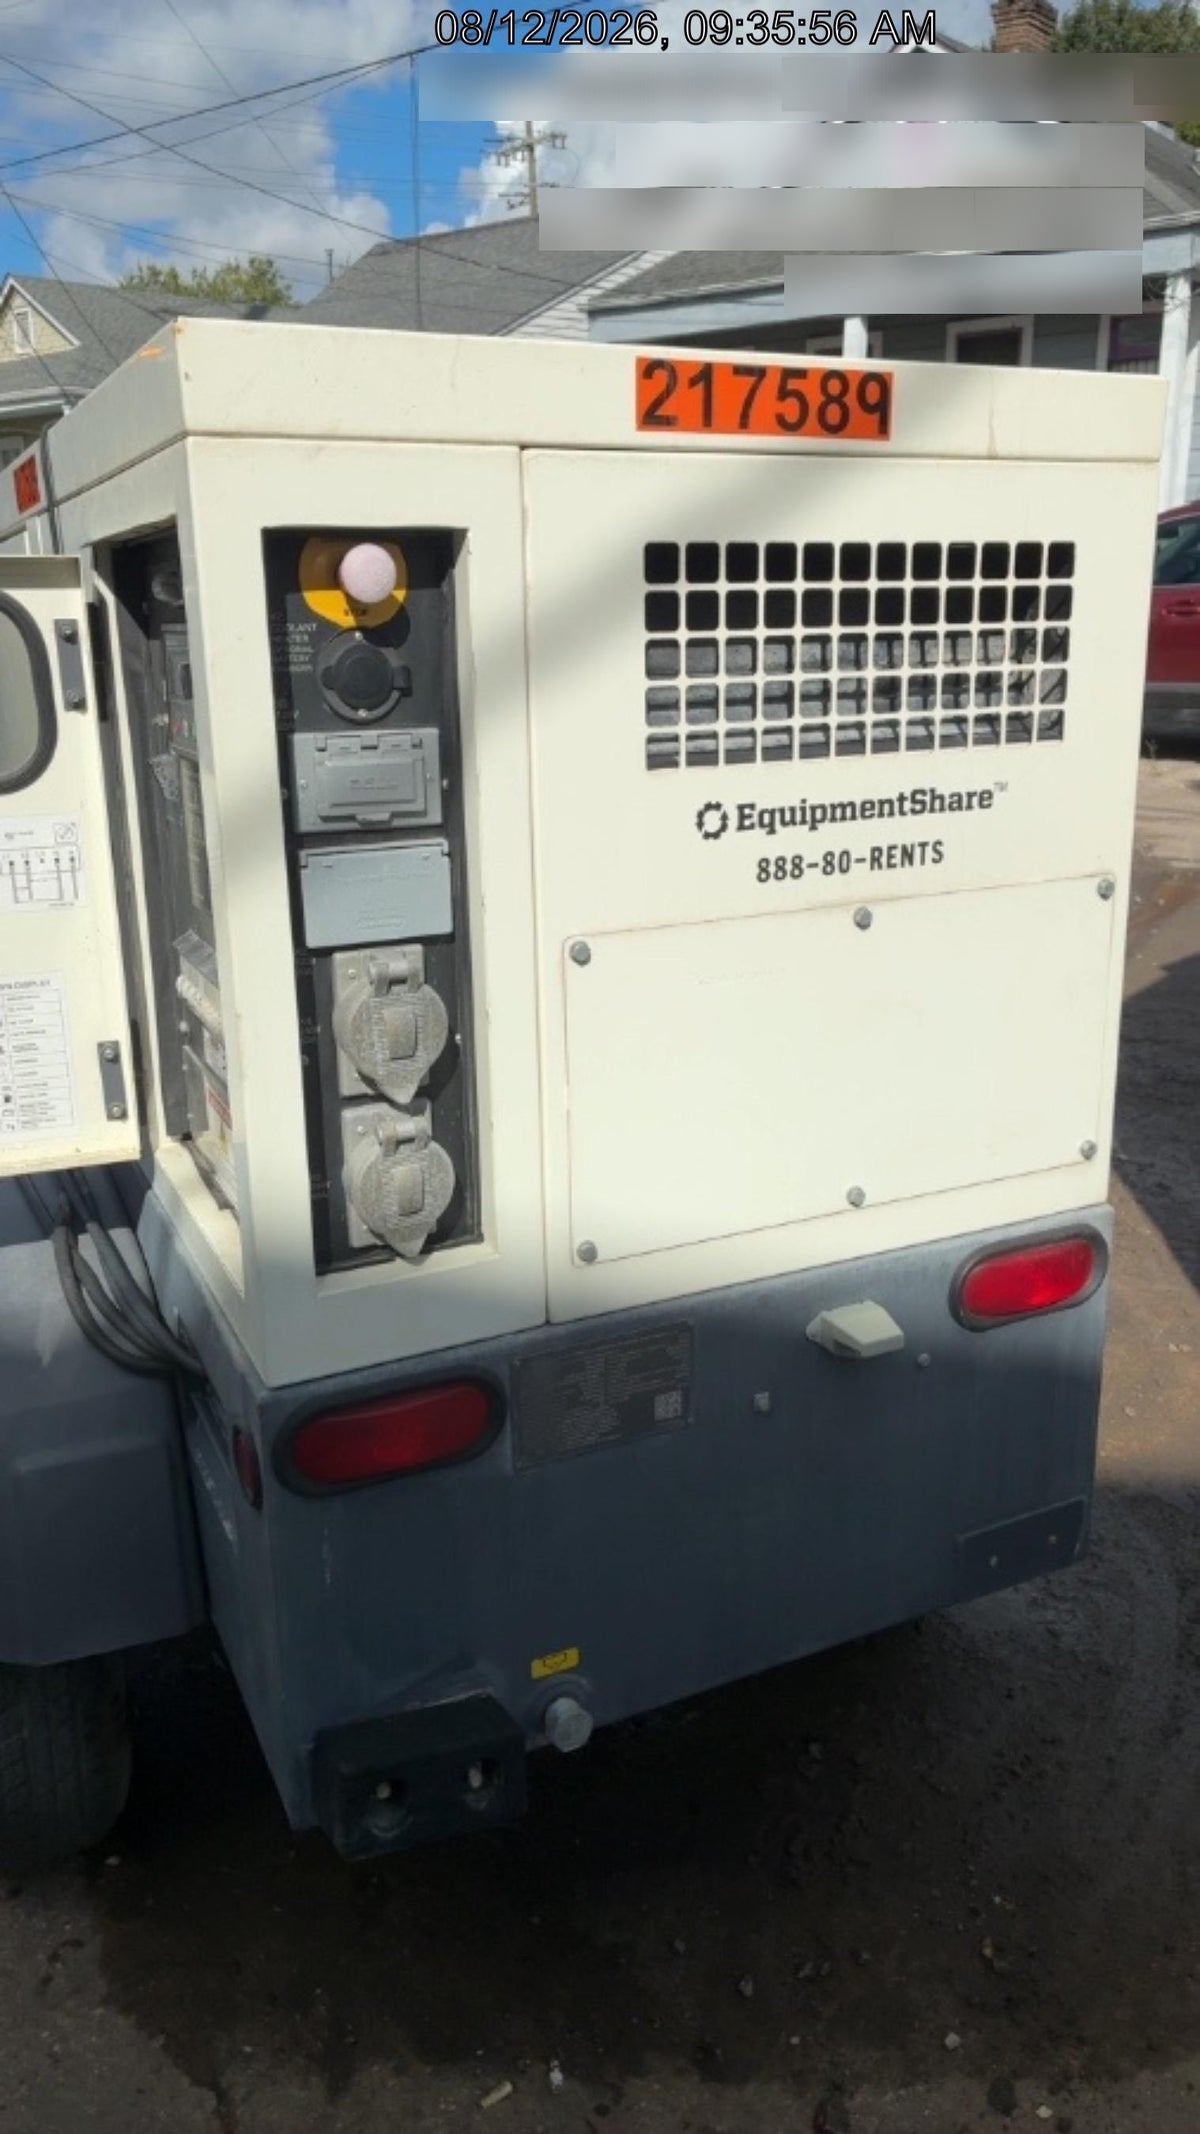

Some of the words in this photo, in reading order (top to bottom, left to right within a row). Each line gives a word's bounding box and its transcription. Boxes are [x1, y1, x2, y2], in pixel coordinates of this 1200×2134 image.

[641, 358, 890, 435] 217589
[735, 786, 995, 836] EquipmentShare
[756, 839, 945, 884] 888-80-RENTS
